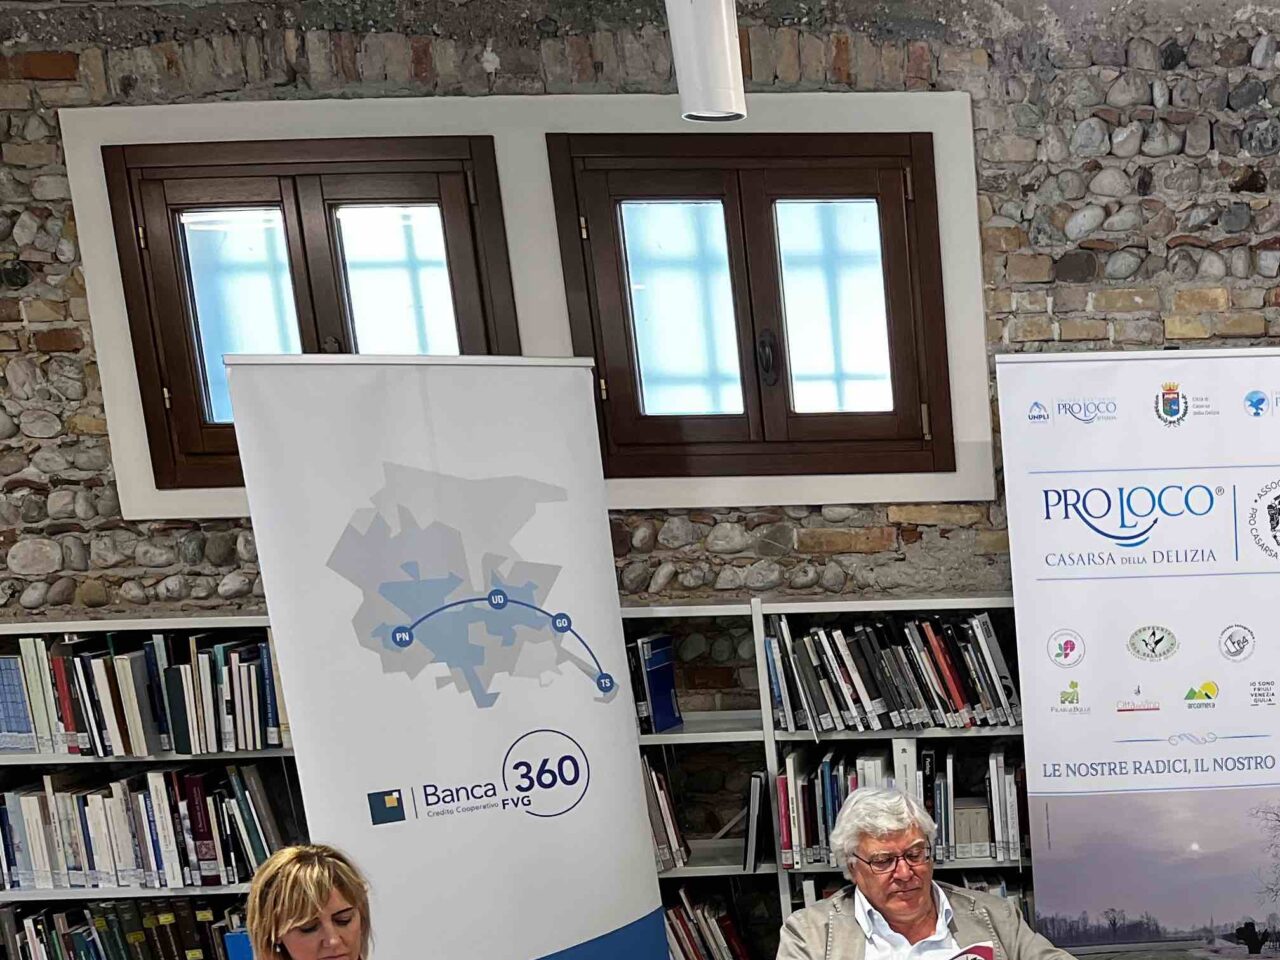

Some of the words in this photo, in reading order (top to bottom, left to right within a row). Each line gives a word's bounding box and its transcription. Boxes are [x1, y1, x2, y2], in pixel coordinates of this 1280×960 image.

[1248, 508, 1258, 526] PRO
[1250, 528, 1279, 559] CASARSA
[1045, 552, 1117, 567] CASARSA
[1152, 549, 1217, 564] DELIZIA
[492, 594, 504, 606] UD
[556, 618, 568, 628] GO
[396, 632, 410, 643] PN
[600, 678, 611, 688] TS
[1042, 763, 1063, 778] LE
[1065, 760, 1129, 777] NOSTRE
[1133, 758, 1192, 776] RADICI,
[1194, 757, 1210, 773] IL
[1212, 755, 1276, 773] NOSTRO
[423, 780, 498, 807] Banca
[511, 754, 581, 793] 360
[426, 808, 455, 818] Credito
[455, 802, 500, 816] Cooperativo
[501, 794, 533, 810] FVG
